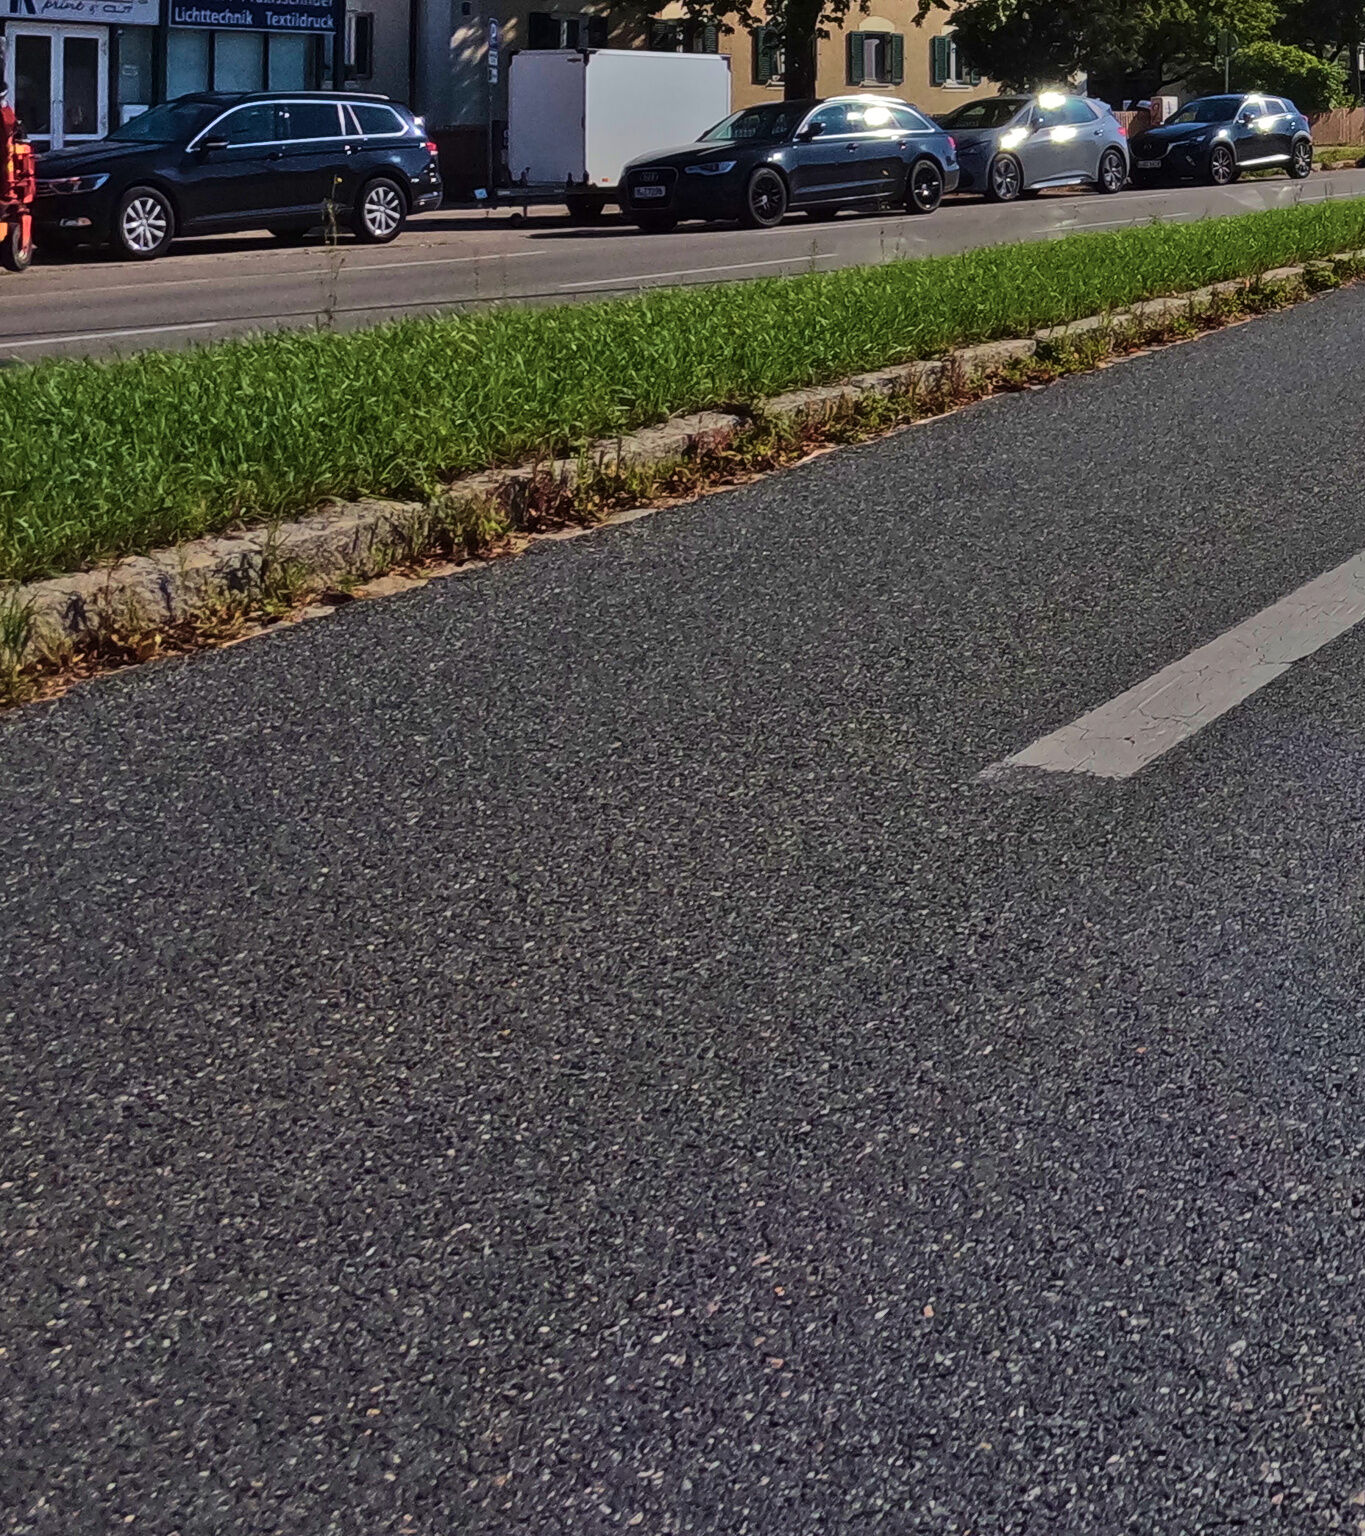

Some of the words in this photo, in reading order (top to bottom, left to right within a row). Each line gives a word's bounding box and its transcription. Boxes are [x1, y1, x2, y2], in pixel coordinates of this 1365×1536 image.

[40, 0, 84, 14] print
[174, 6, 253, 25] Lichttechnik
[265, 10, 335, 28] Textildruck
